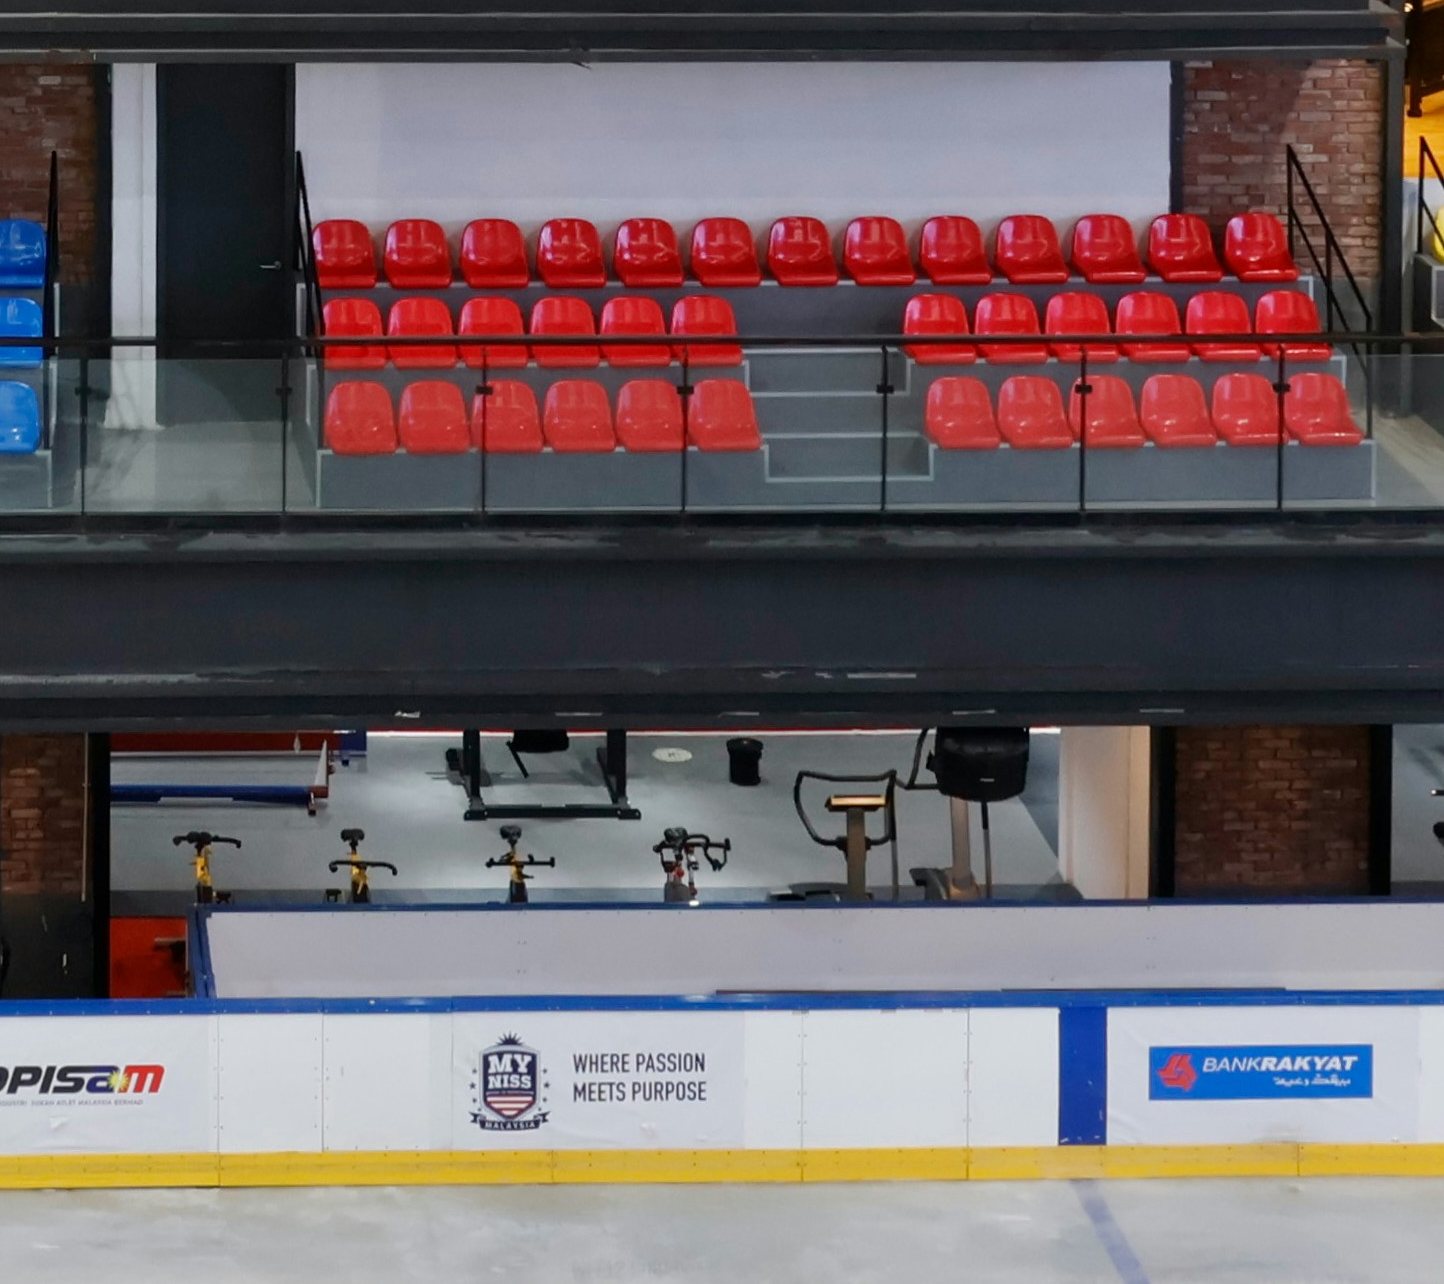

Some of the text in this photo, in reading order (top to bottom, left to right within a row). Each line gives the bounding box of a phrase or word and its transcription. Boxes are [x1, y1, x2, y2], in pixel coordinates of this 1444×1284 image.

[487, 1053, 533, 1074] MY
[573, 1052, 705, 1073] WHERE PASSION
[487, 1074, 533, 1090] NISS
[573, 1081, 707, 1102] MEETS PURPOSE
[484, 1121, 536, 1131] MALAYSIA
